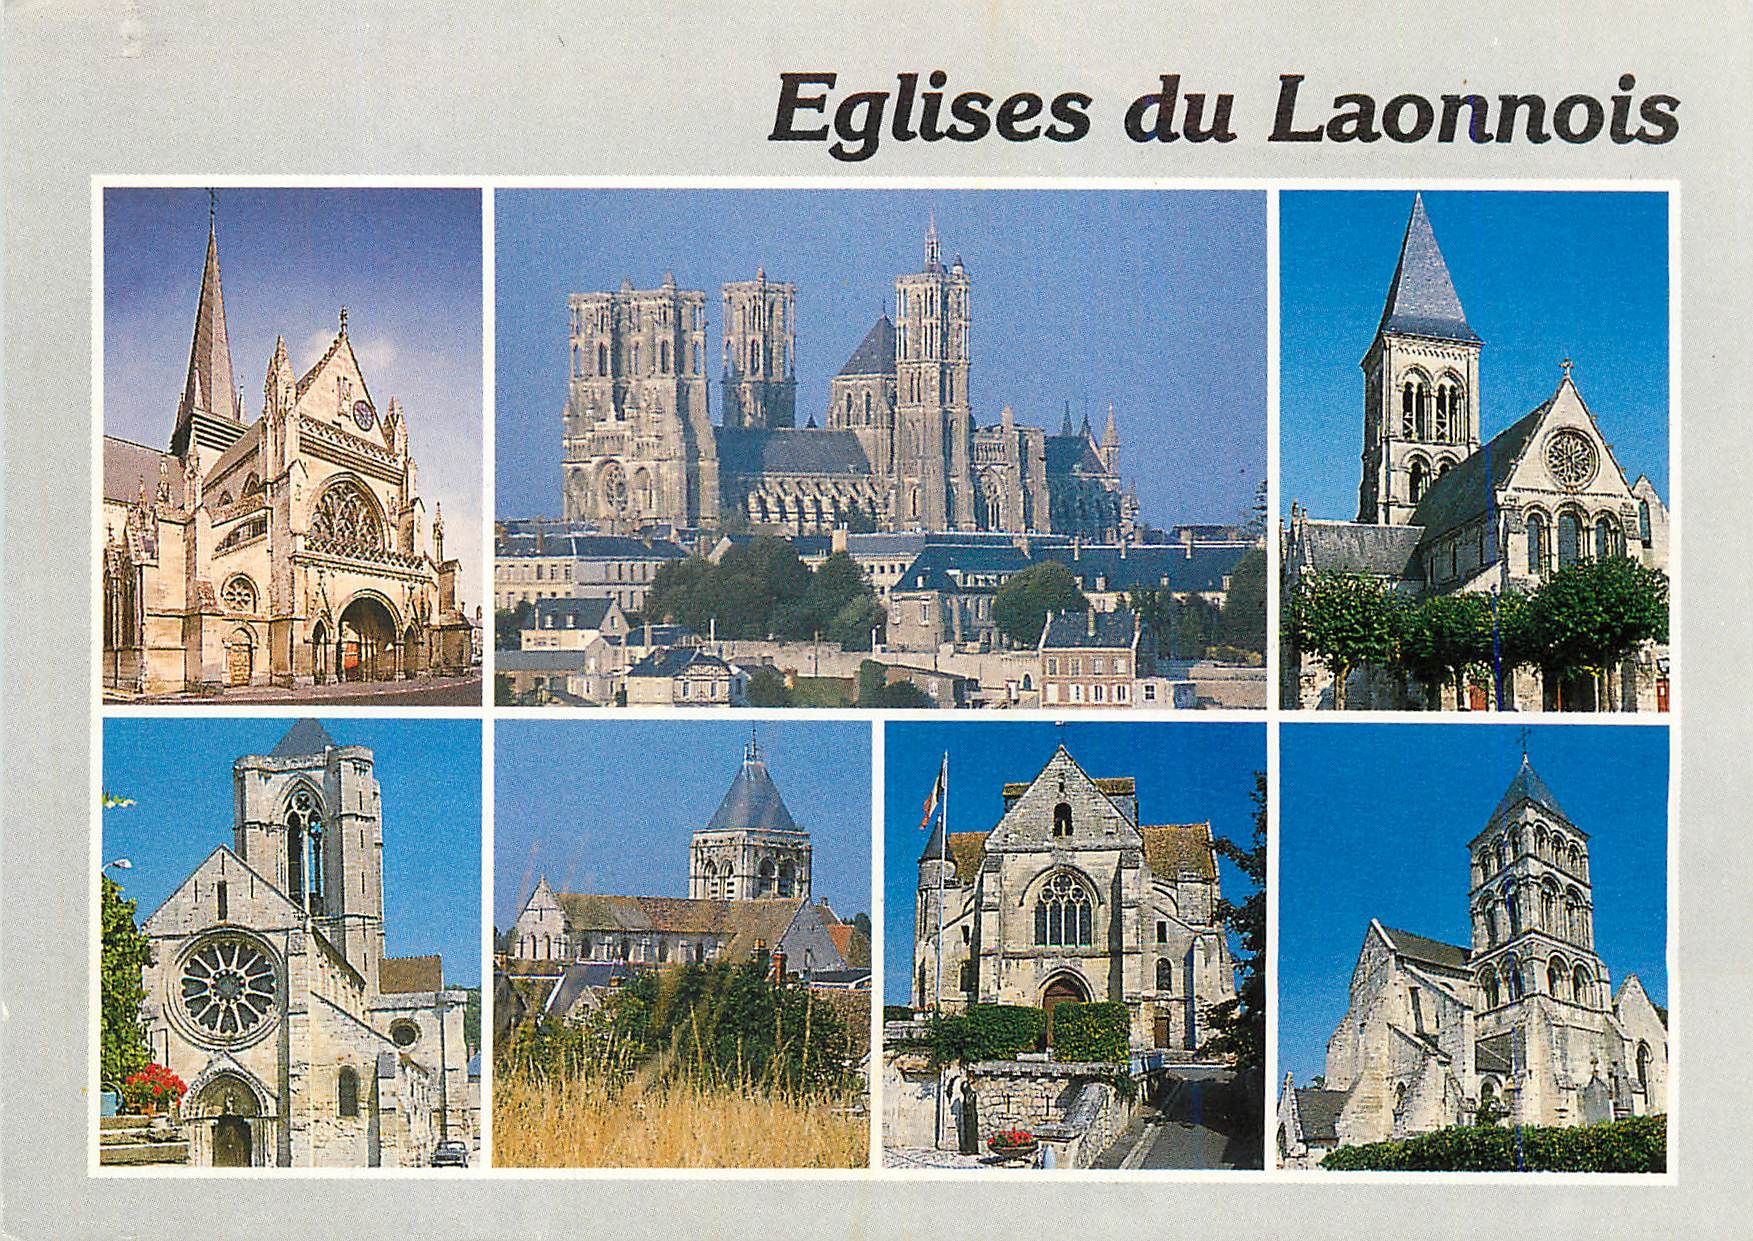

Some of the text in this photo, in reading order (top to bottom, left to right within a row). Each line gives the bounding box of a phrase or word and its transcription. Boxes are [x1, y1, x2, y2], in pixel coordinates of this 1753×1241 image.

[767, 71, 1681, 163] Eglises du Laonnois
